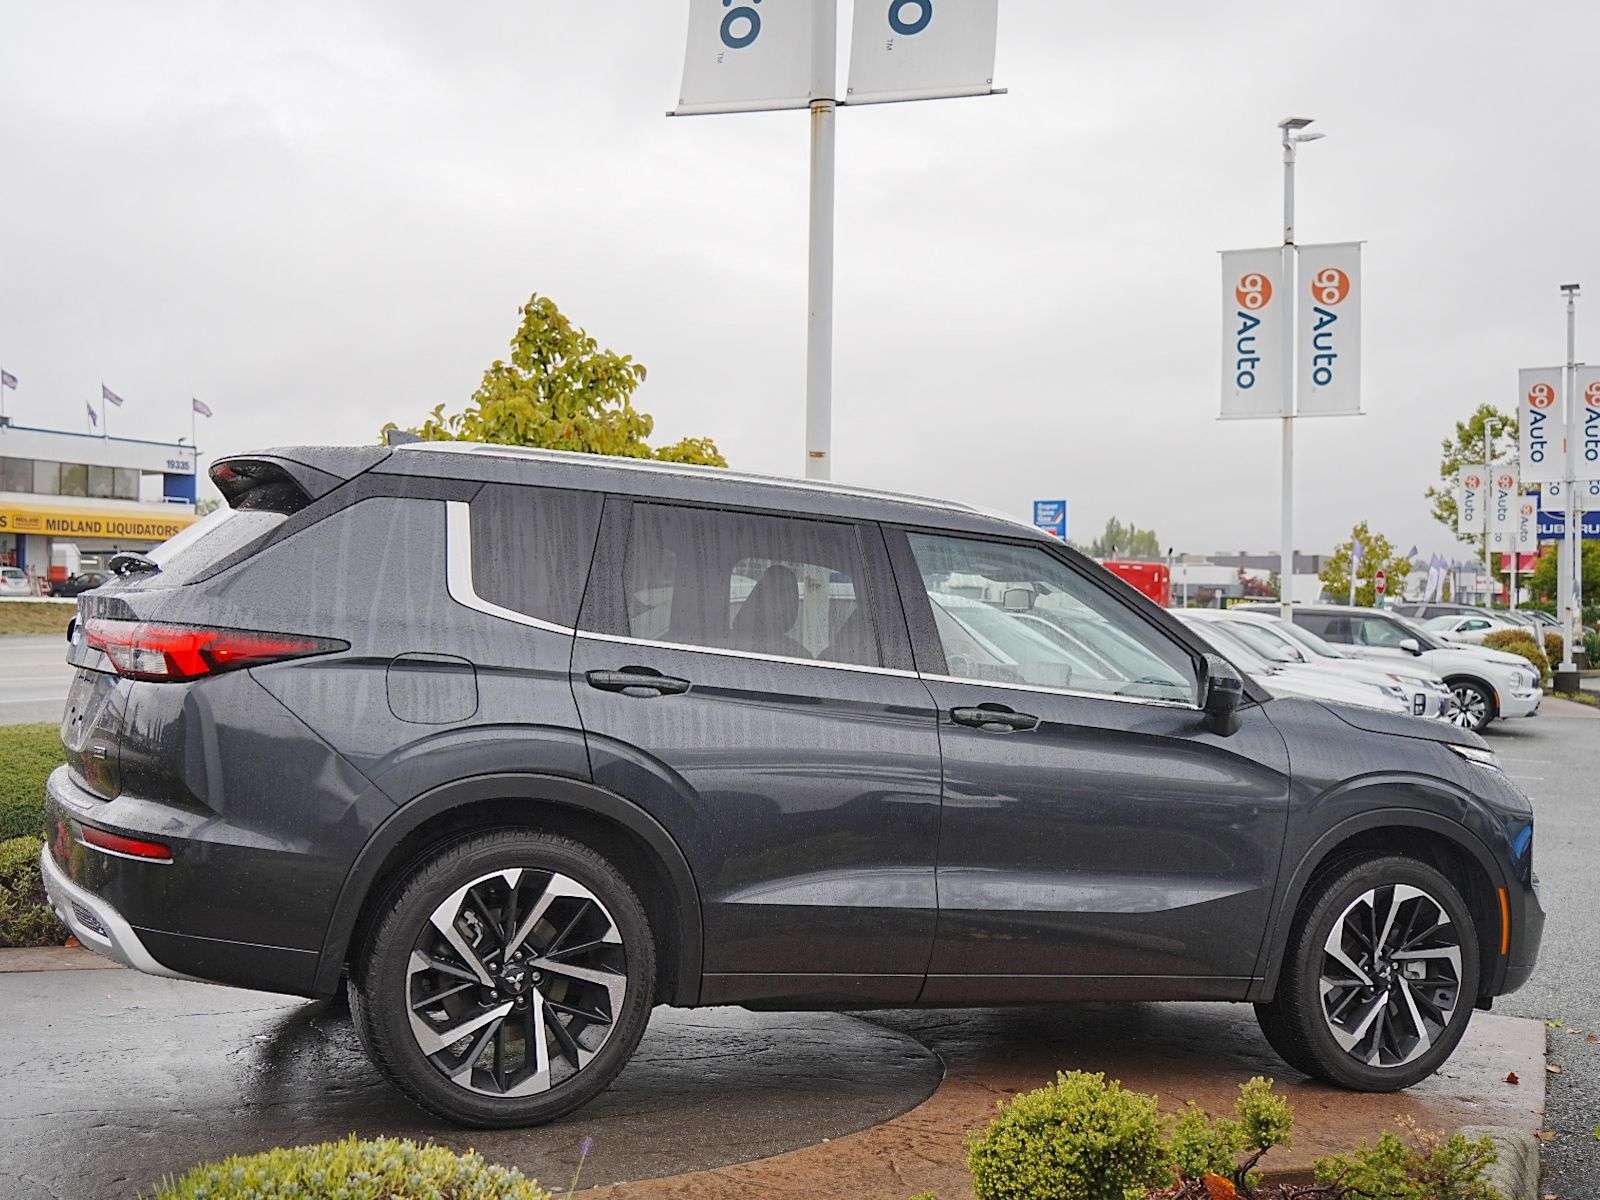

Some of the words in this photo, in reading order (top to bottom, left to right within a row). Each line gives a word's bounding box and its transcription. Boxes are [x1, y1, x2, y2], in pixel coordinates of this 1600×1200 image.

[1236, 311, 1261, 390] Auto
[1312, 306, 1338, 386] Auto
[1529, 409, 1548, 463] Auto
[1585, 407, 1600, 461] Auto
[166, 460, 190, 471] 19335
[1464, 490, 1475, 521] Auto
[1497, 490, 1508, 521] Auto
[46, 519, 102, 533] MIDLAND
[106, 522, 179, 536] LIQUIDATORS
[1520, 516, 1529, 542] Auto
